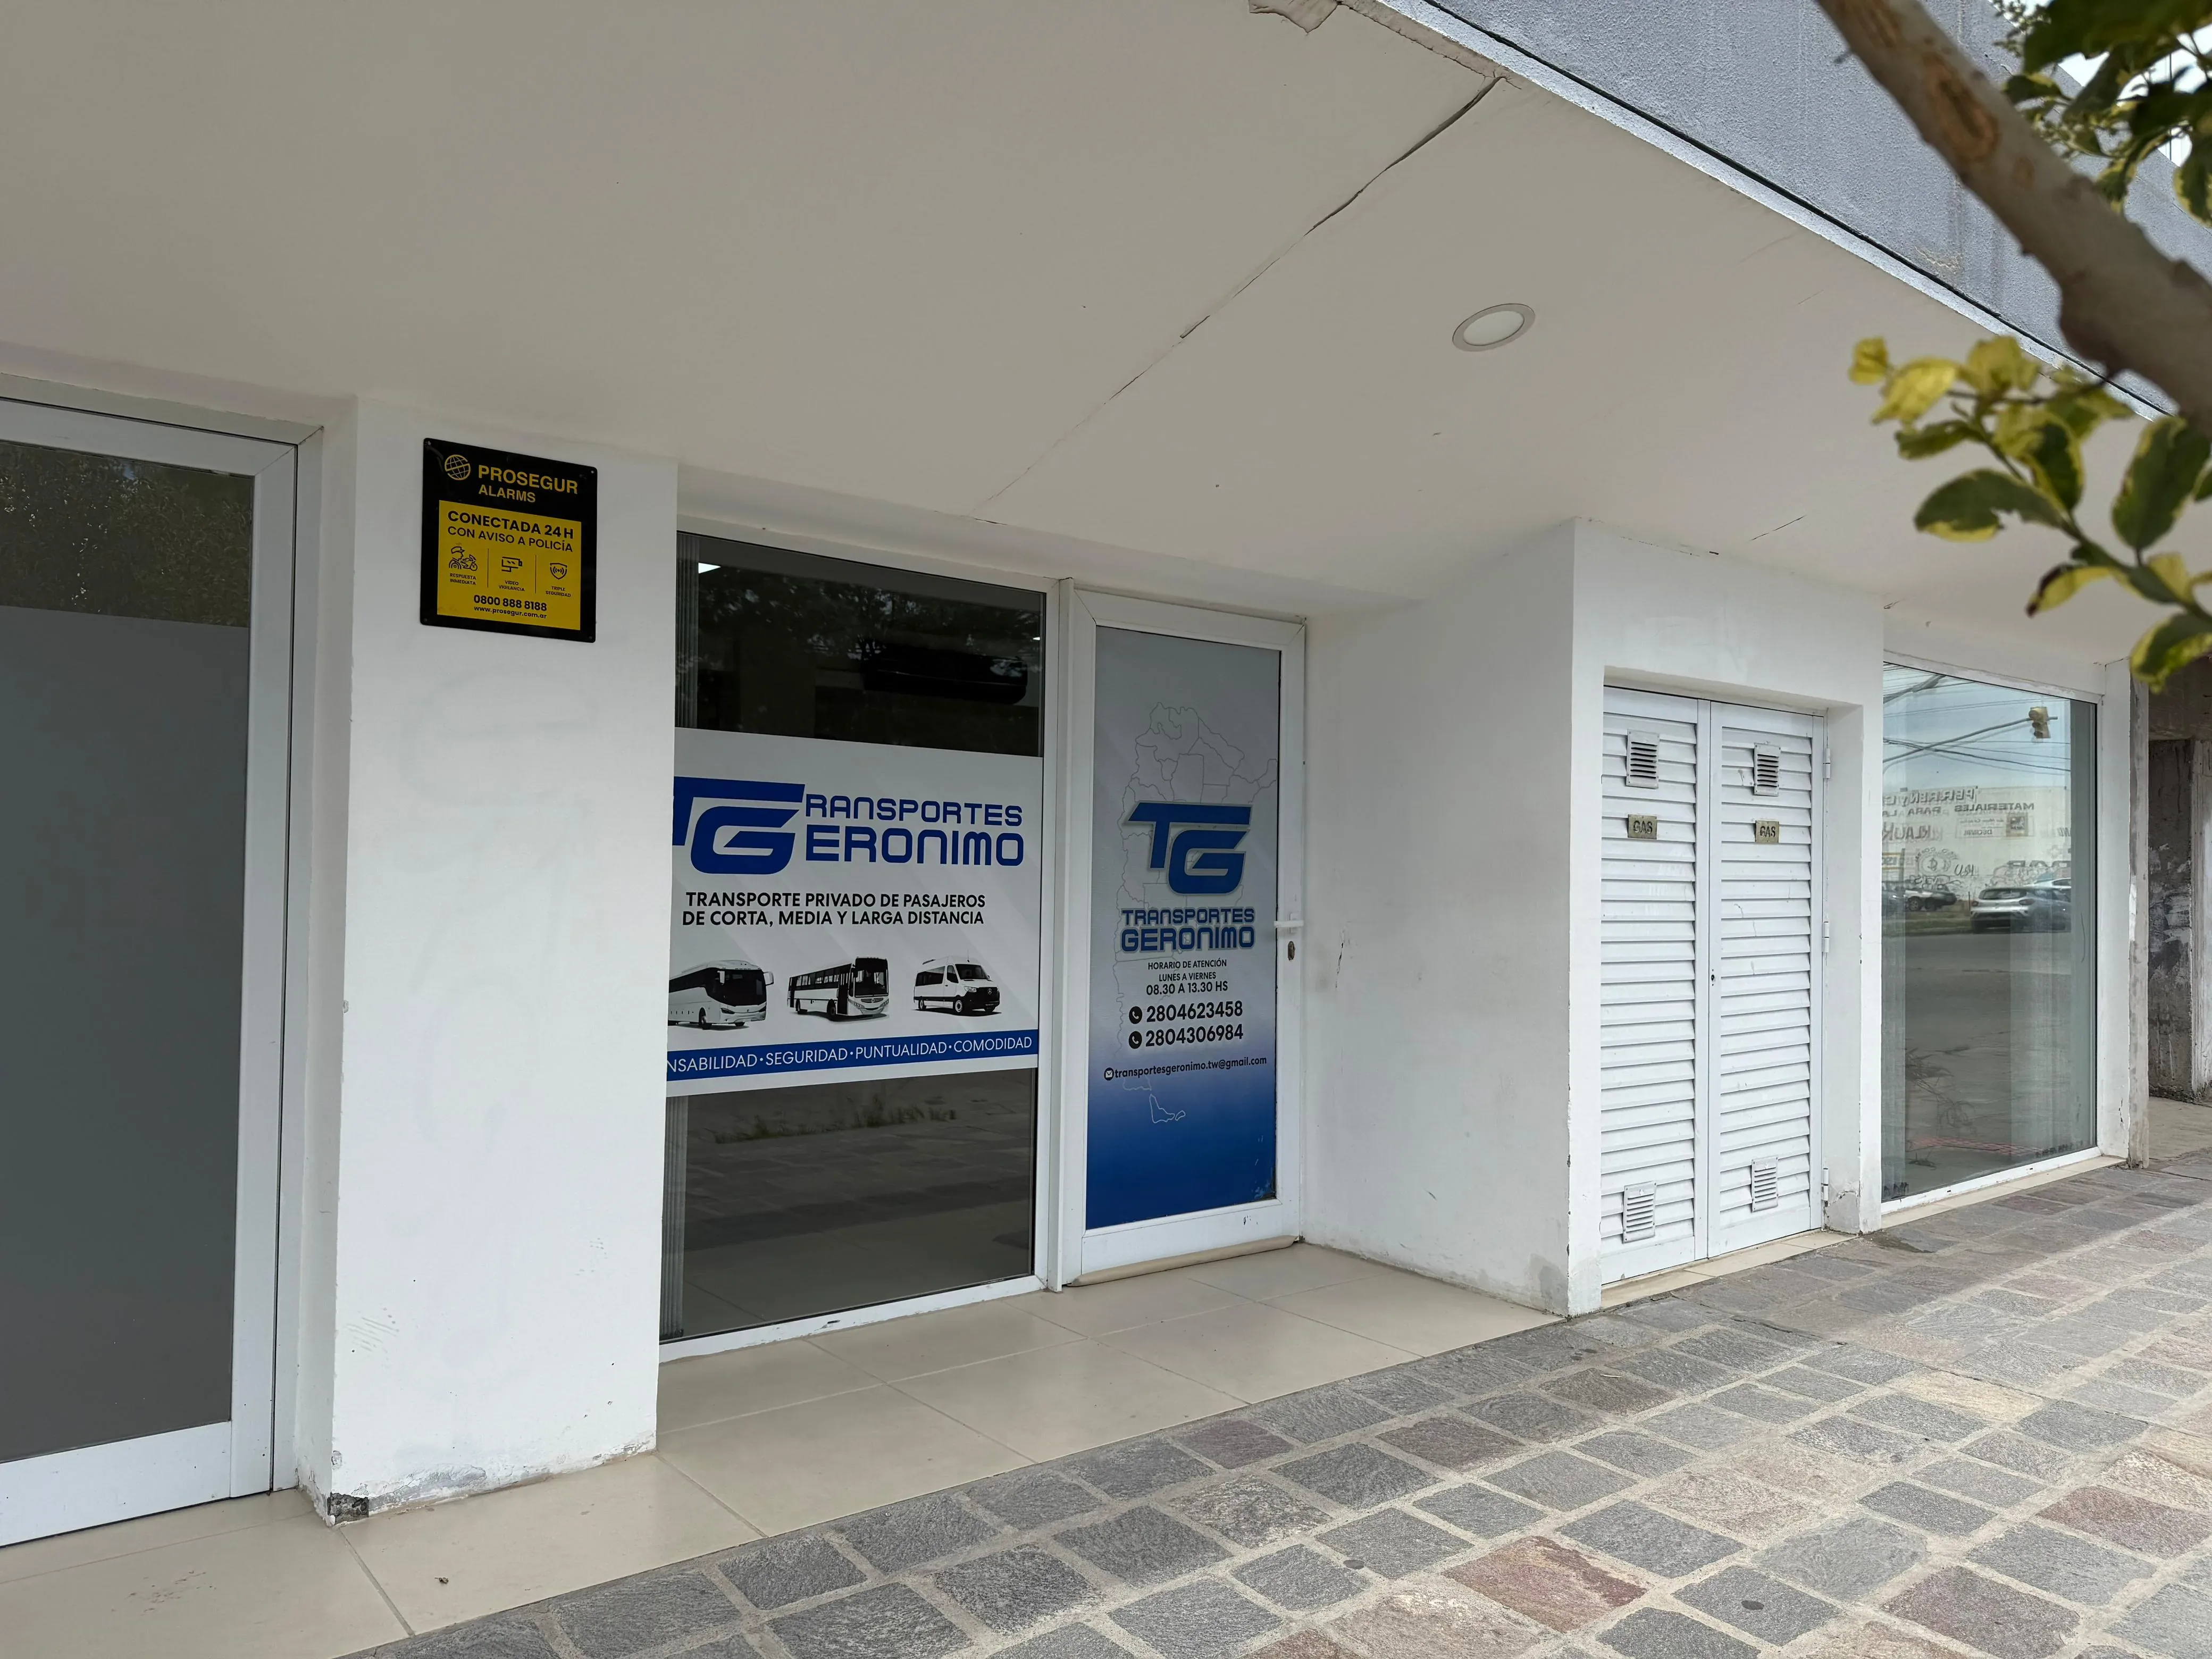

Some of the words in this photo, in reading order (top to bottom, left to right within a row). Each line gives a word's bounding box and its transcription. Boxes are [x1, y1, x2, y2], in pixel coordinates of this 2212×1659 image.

[479, 465, 577, 495] PROSEGUR
[479, 484, 535, 502] ALARMS
[448, 510, 541, 534] CONECTADA
[544, 525, 561, 538] 24
[564, 527, 573, 539] H
[448, 526, 475, 538] CON
[479, 531, 514, 543] AVISO
[518, 537, 525, 545] A
[529, 539, 573, 552] POLICÍA
[474, 594, 500, 606] 0800
[503, 598, 522, 608] 888
[524, 601, 547, 611] 8188
[474, 606, 547, 618] www.prosegur.com.ar
[1633, 820, 1653, 834] GAS
[1759, 826, 1776, 837] GAS
[1127, 801, 1253, 895] TG
[686, 892, 800, 907] TRANSPORTE
[805, 893, 876, 907] PRIVADO
[881, 894, 899, 907] DE
[903, 894, 985, 908] PASAJEROS
[683, 911, 705, 925] DE
[710, 910, 773, 927] CORTA,
[778, 911, 832, 925] MEDIA
[836, 911, 848, 924] Y
[852, 911, 903, 925] LARGA
[908, 911, 984, 924] DISTANCIA
[1121, 908, 1255, 925] TRANSPORTES
[1120, 926, 1254, 952] GERONIMO
[1148, 961, 1180, 970] HORARIO
[1193, 958, 1227, 968] ATENCIÓN
[1159, 973, 1180, 982] LUNES
[1146, 983, 1175, 995] 08.30
[1178, 983, 1185, 993] A
[1188, 982, 1212, 992] 13.30
[1216, 981, 1228, 992] HS
[1146, 1001, 1243, 1022] 2804623458
[1145, 1024, 1243, 1047] 2804306984
[954, 1037, 1032, 1052] COMODIDAD
[1115, 1057, 1267, 1078] transportesgeronimo.tw@gmail.com
